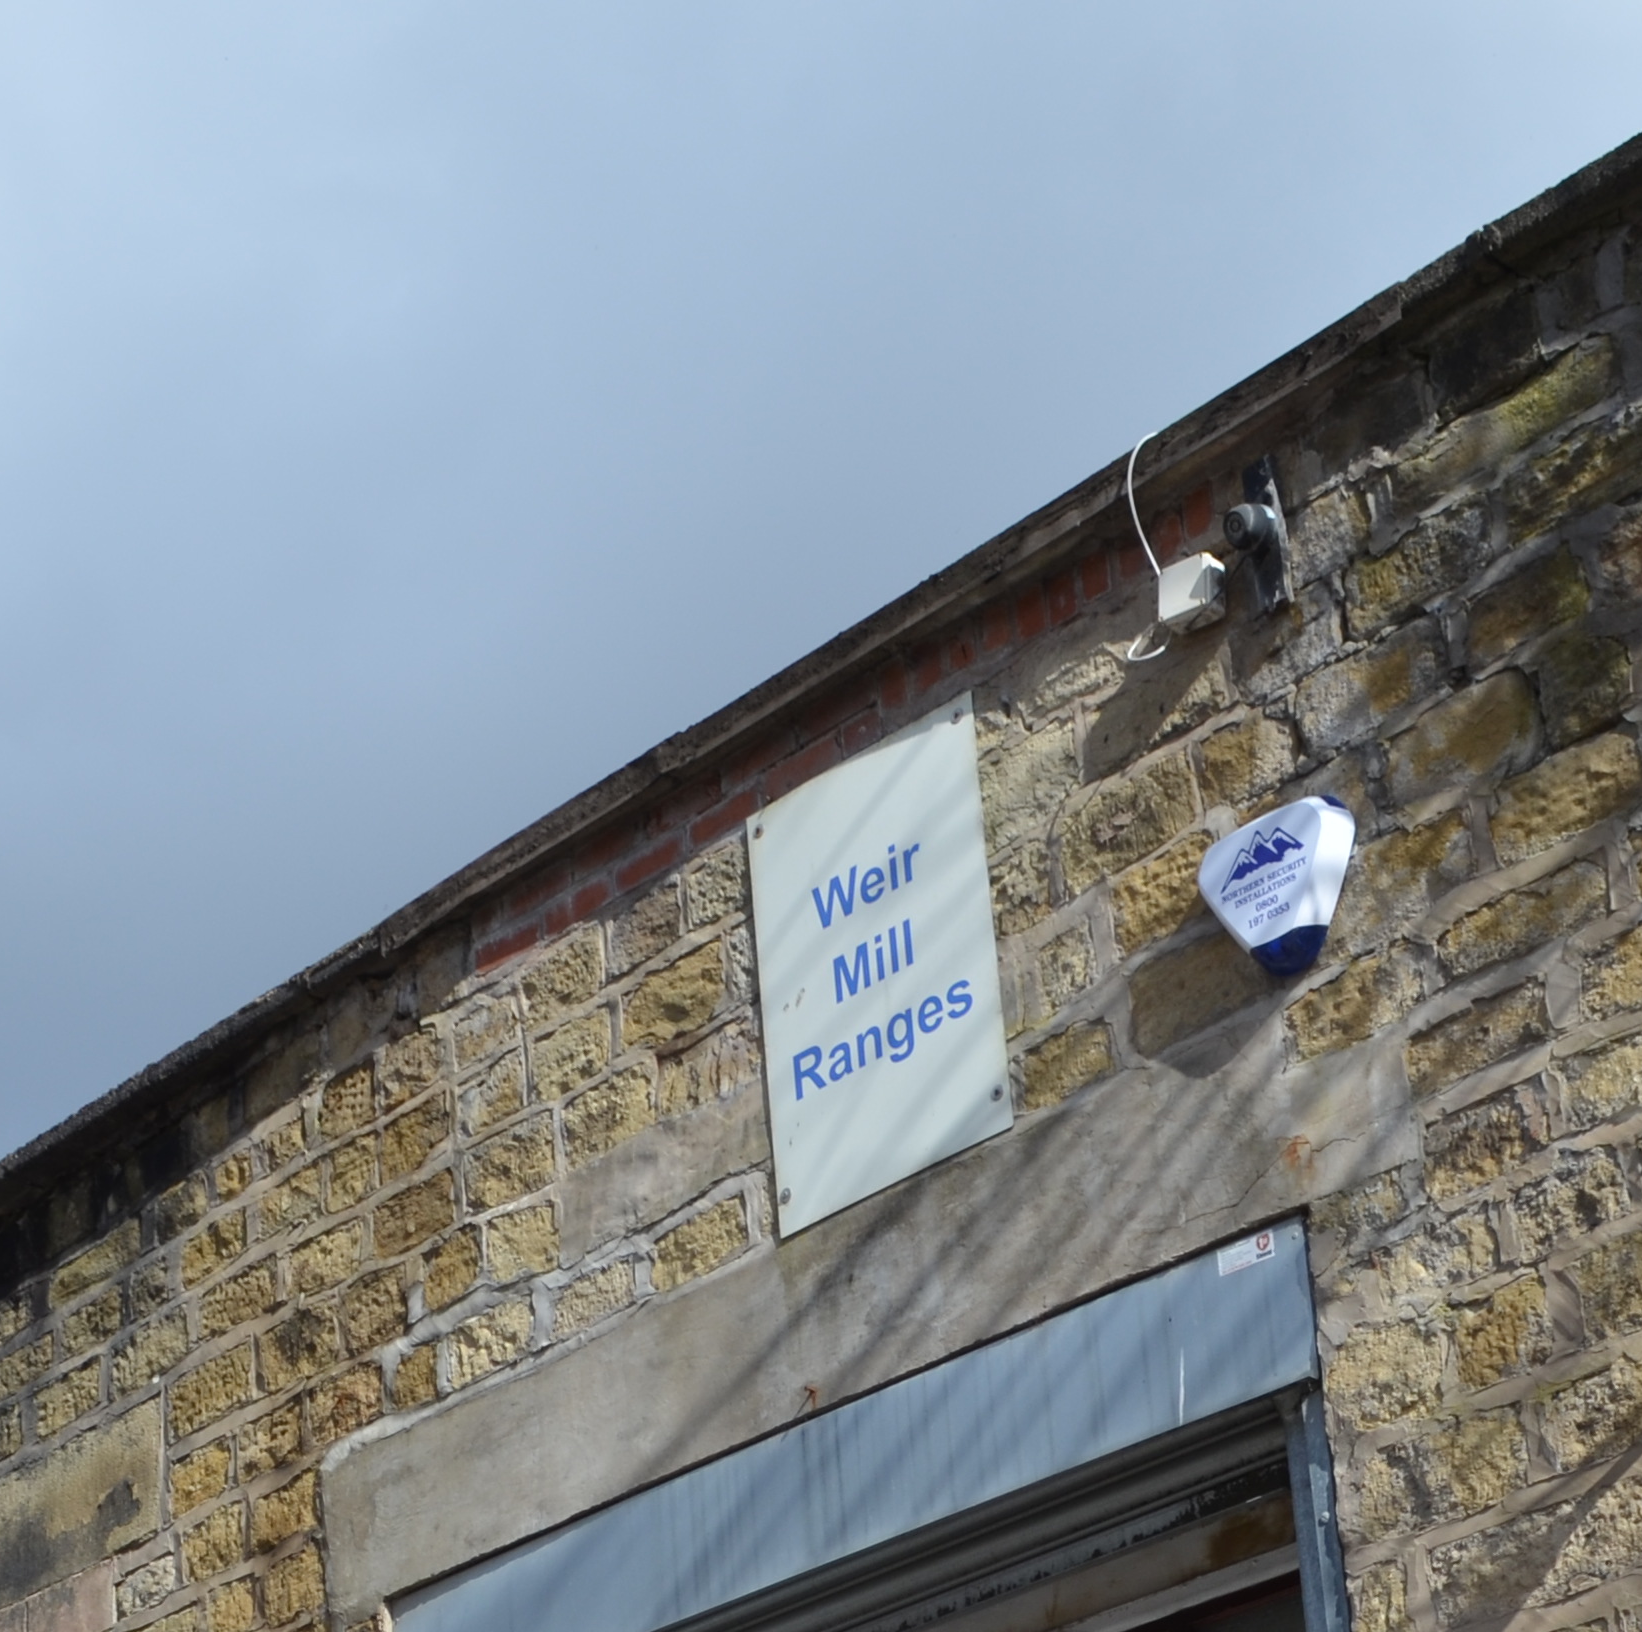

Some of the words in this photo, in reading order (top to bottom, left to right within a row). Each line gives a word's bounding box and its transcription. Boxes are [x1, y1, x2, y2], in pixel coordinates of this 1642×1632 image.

[811, 843, 920, 930] Weir
[1221, 877, 1265, 905] NORTHERN
[1266, 856, 1307, 881] SECURITY
[1234, 872, 1297, 909] INSTALLATIONS
[1255, 894, 1279, 912] 0800
[1248, 913, 1264, 929] 197
[832, 918, 914, 1004] Mill
[792, 979, 973, 1101] Ranges
